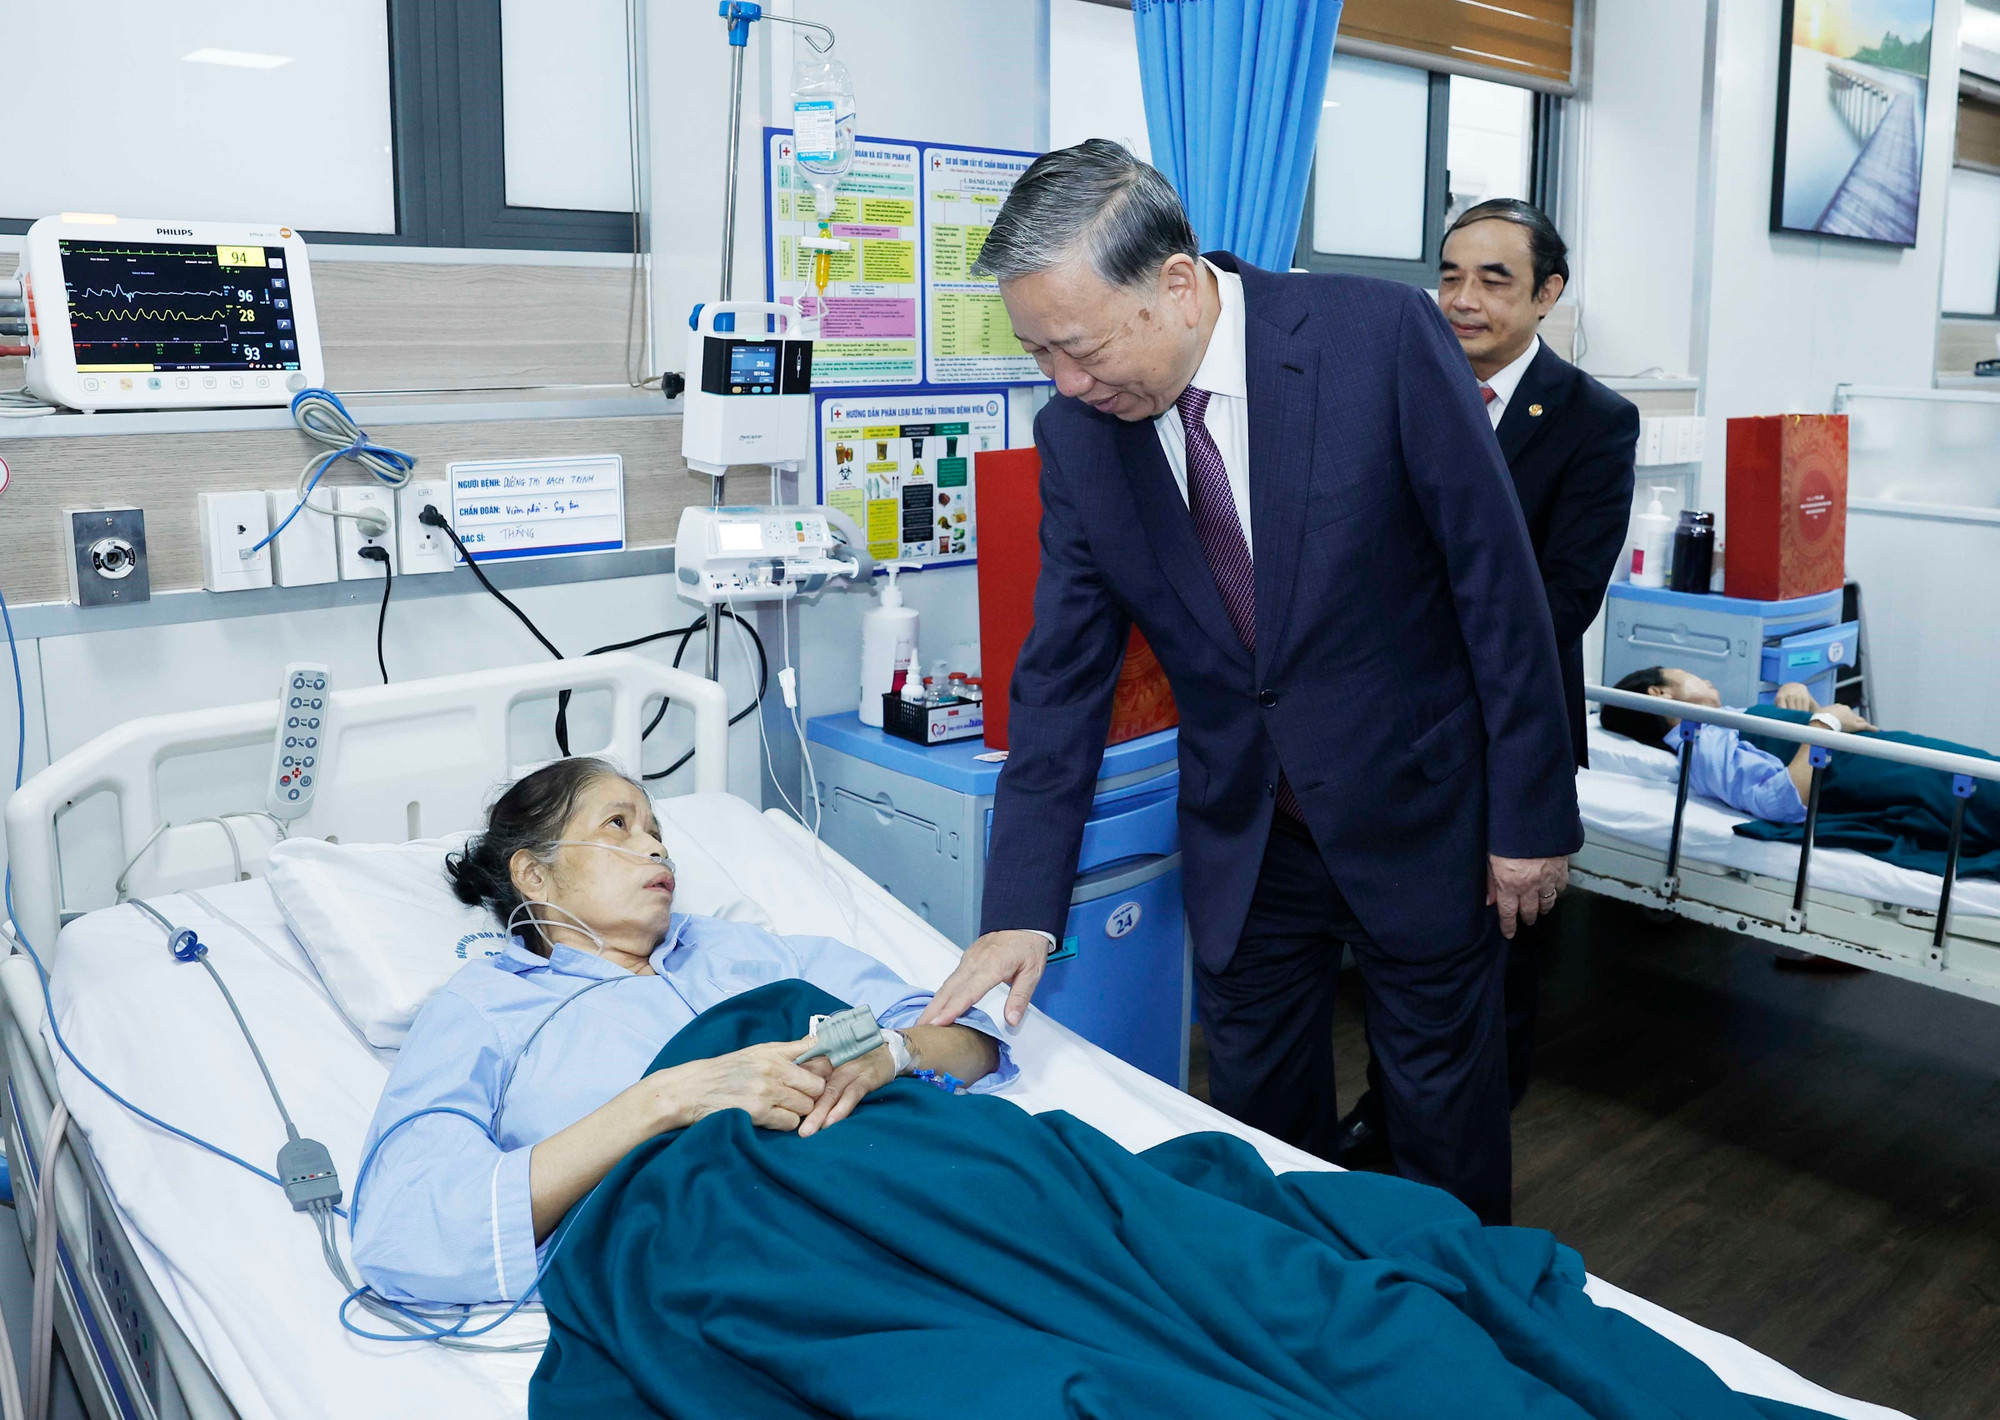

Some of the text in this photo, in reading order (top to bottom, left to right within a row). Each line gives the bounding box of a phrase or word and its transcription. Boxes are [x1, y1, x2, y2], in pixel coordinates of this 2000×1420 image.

[156, 228, 194, 237] PHILIPS
[231, 251, 248, 264] 94
[237, 289, 253, 303] 96
[238, 309, 255, 322] 28
[243, 346, 260, 360] 93
[937, 406, 956, 415] TRONG
[956, 404, 971, 416] BỆNH
[461, 533, 475, 543] BÁC
[1115, 913, 1133, 935] 24
